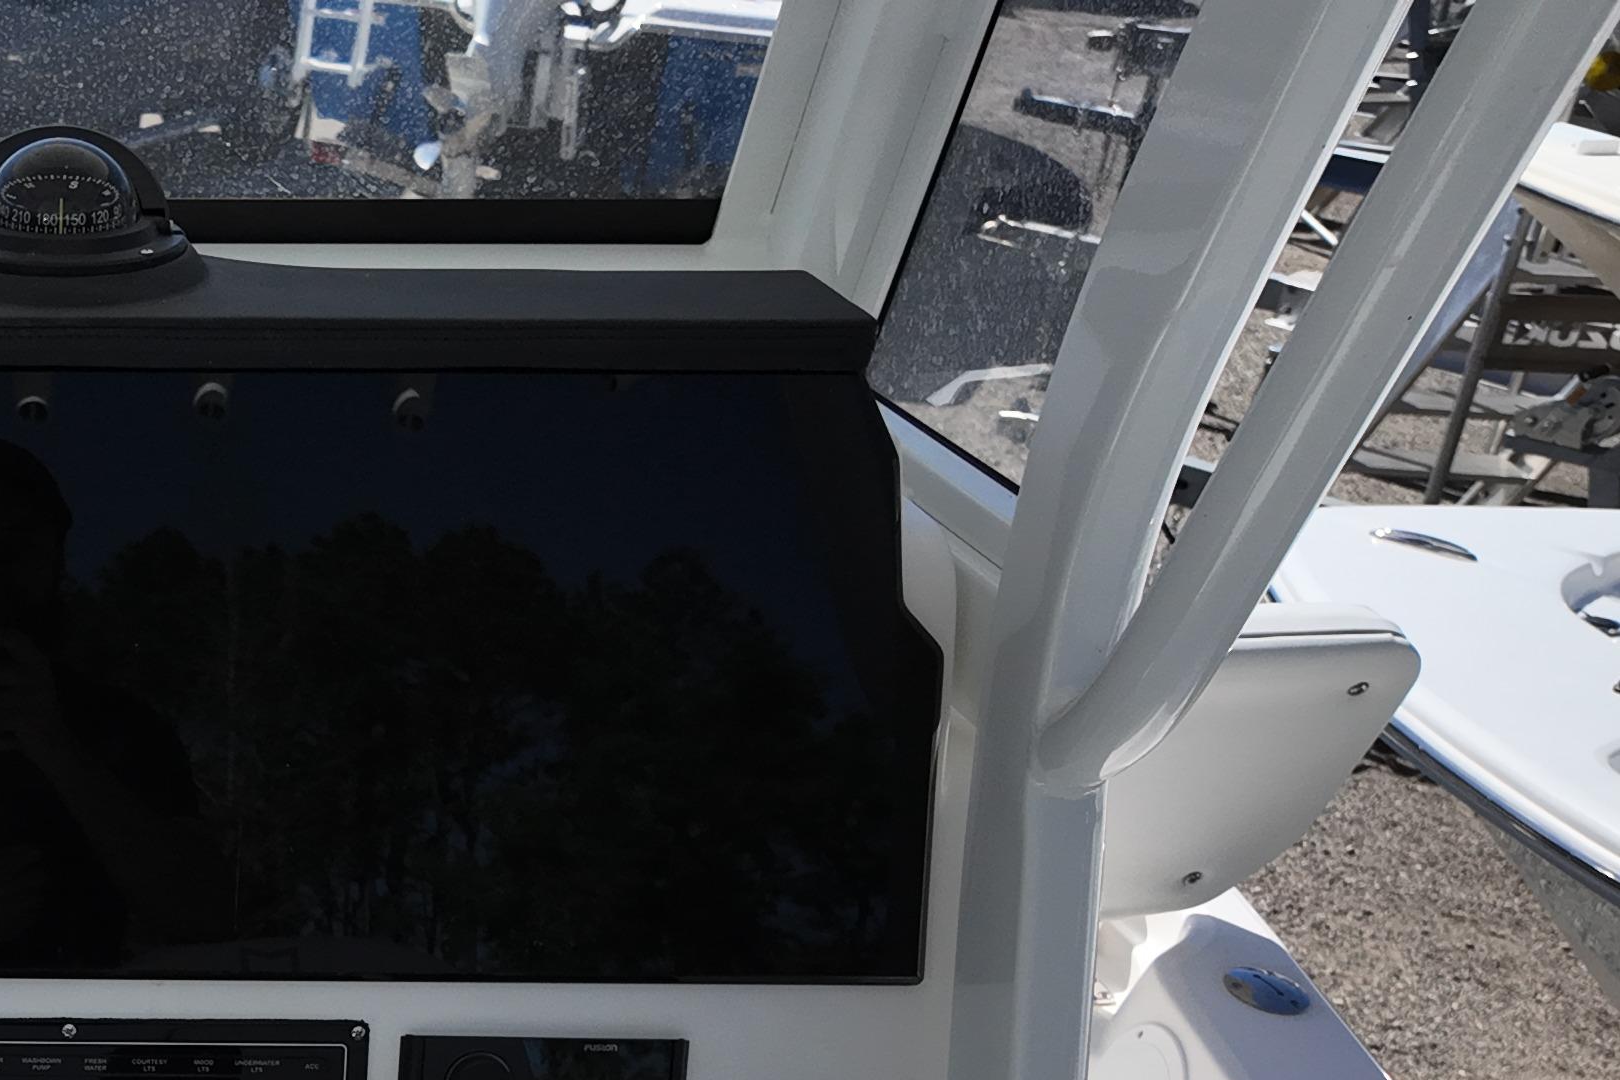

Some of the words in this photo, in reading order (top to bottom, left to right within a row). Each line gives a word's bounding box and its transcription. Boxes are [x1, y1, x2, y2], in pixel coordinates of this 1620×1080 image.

[11, 209, 32, 224] 210
[36, 214, 57, 226] 180
[66, 212, 86, 226] 150
[92, 209, 110, 224] 120
